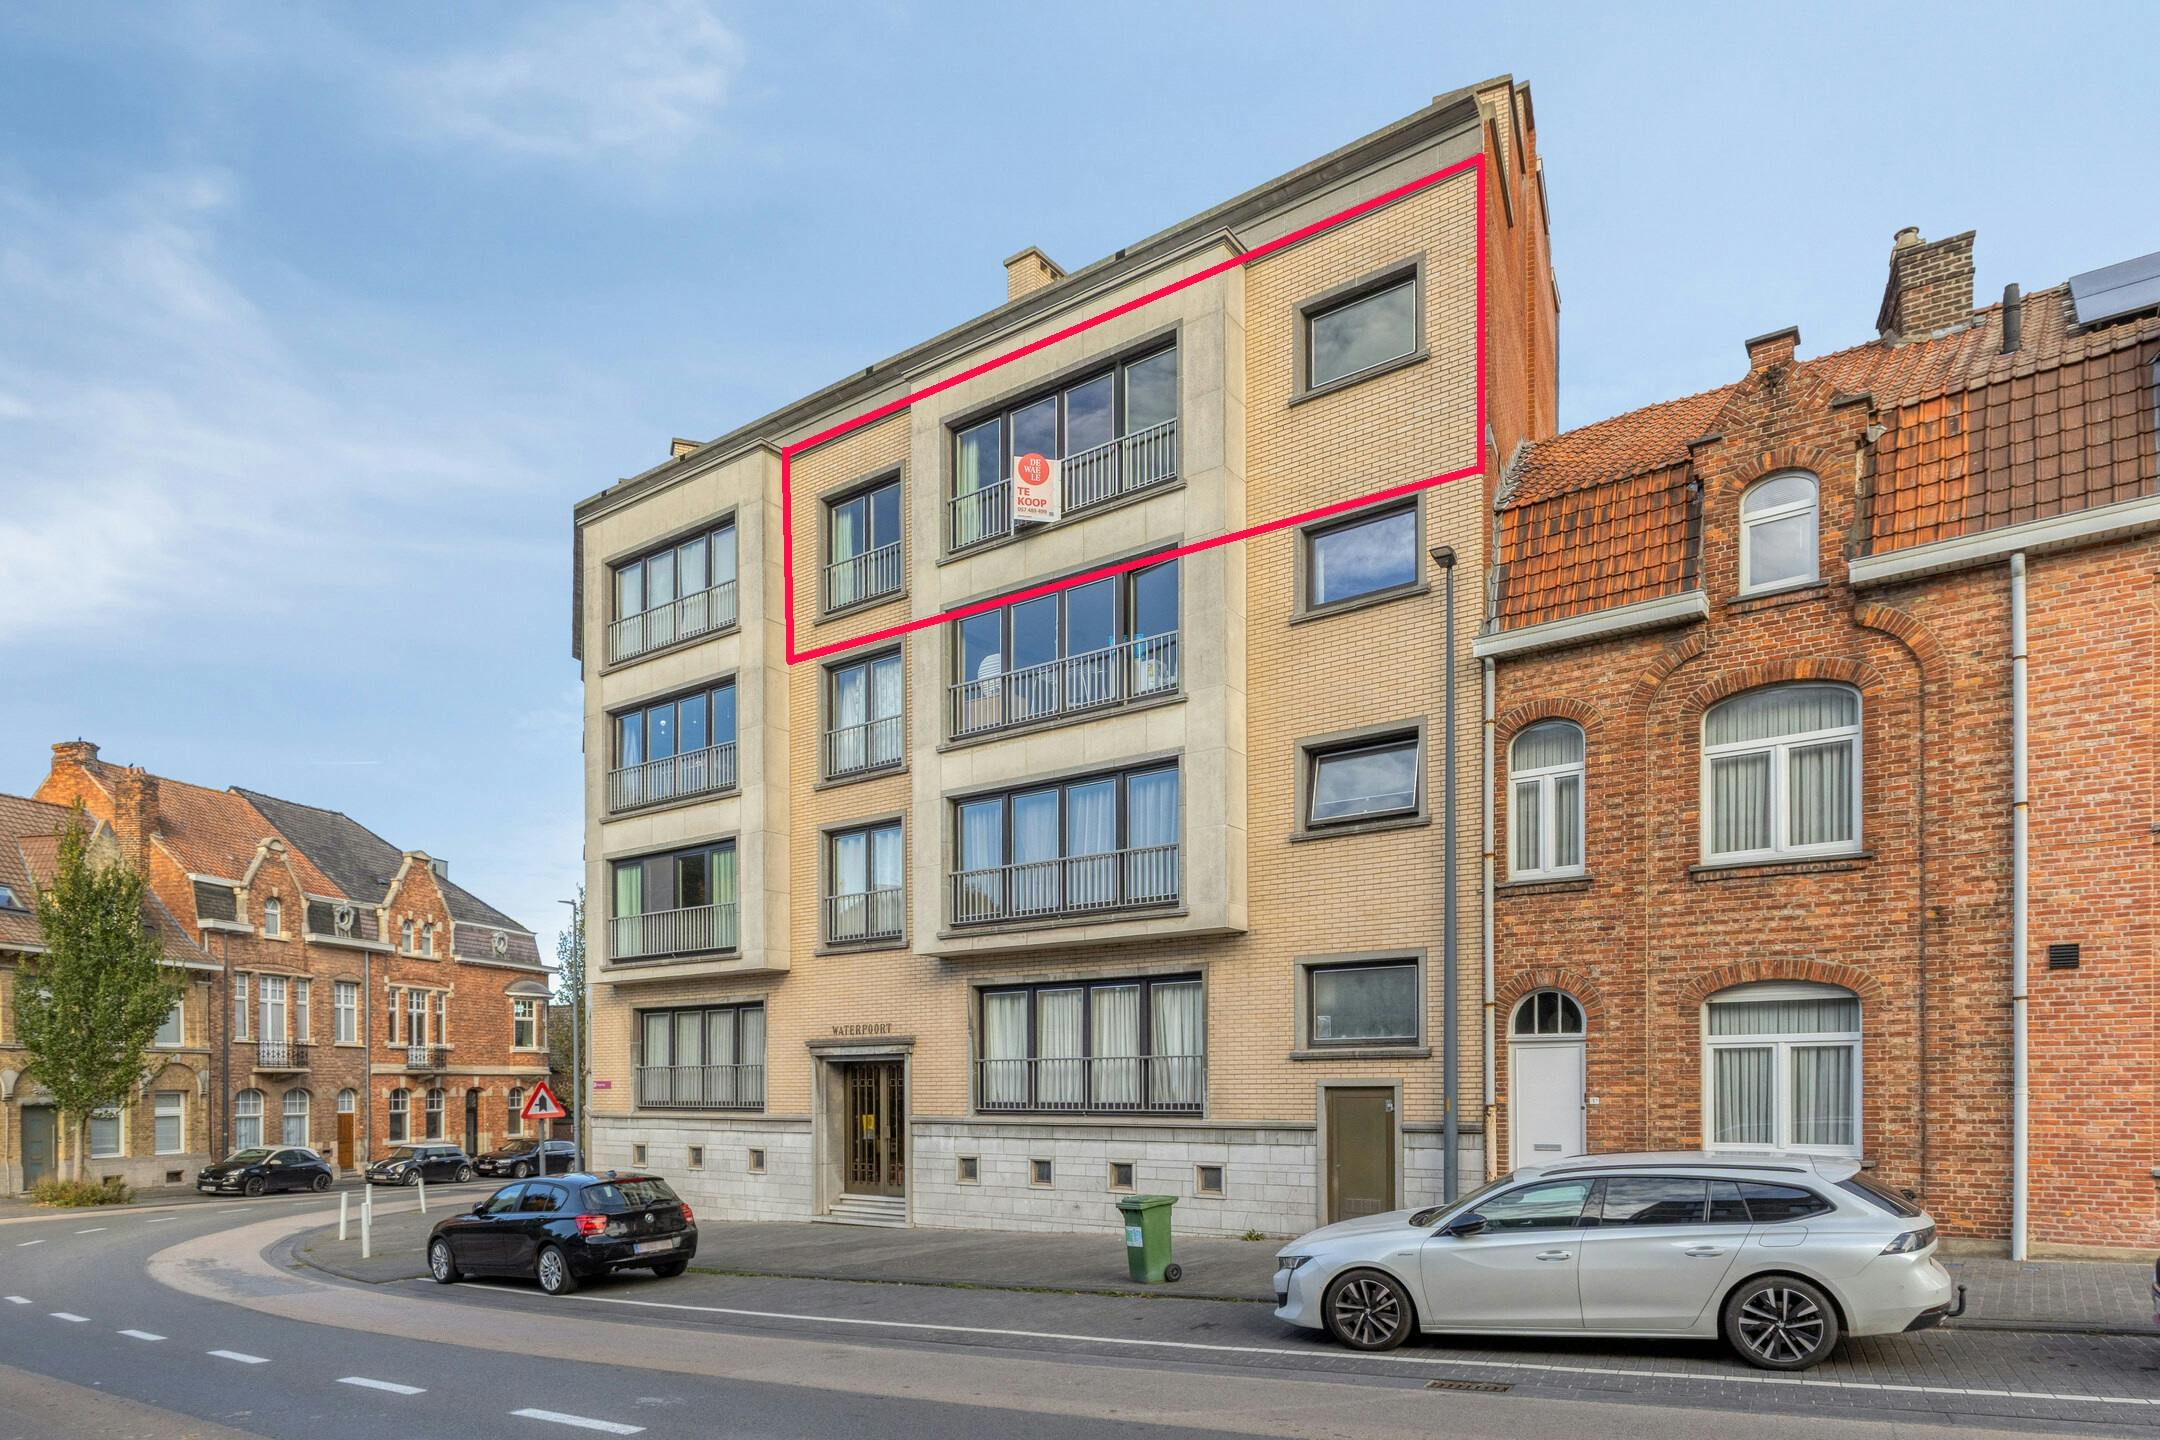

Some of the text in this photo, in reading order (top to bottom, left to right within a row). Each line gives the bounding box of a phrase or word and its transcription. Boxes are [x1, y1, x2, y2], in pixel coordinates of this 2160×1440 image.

[1030, 458, 1041, 466] DE
[1024, 465, 1041, 474] WAE
[1031, 473, 1041, 482] LE
[1017, 486, 1031, 496] TE
[1017, 497, 1047, 507] KOOP
[832, 1023, 892, 1036] WATERPOORT
